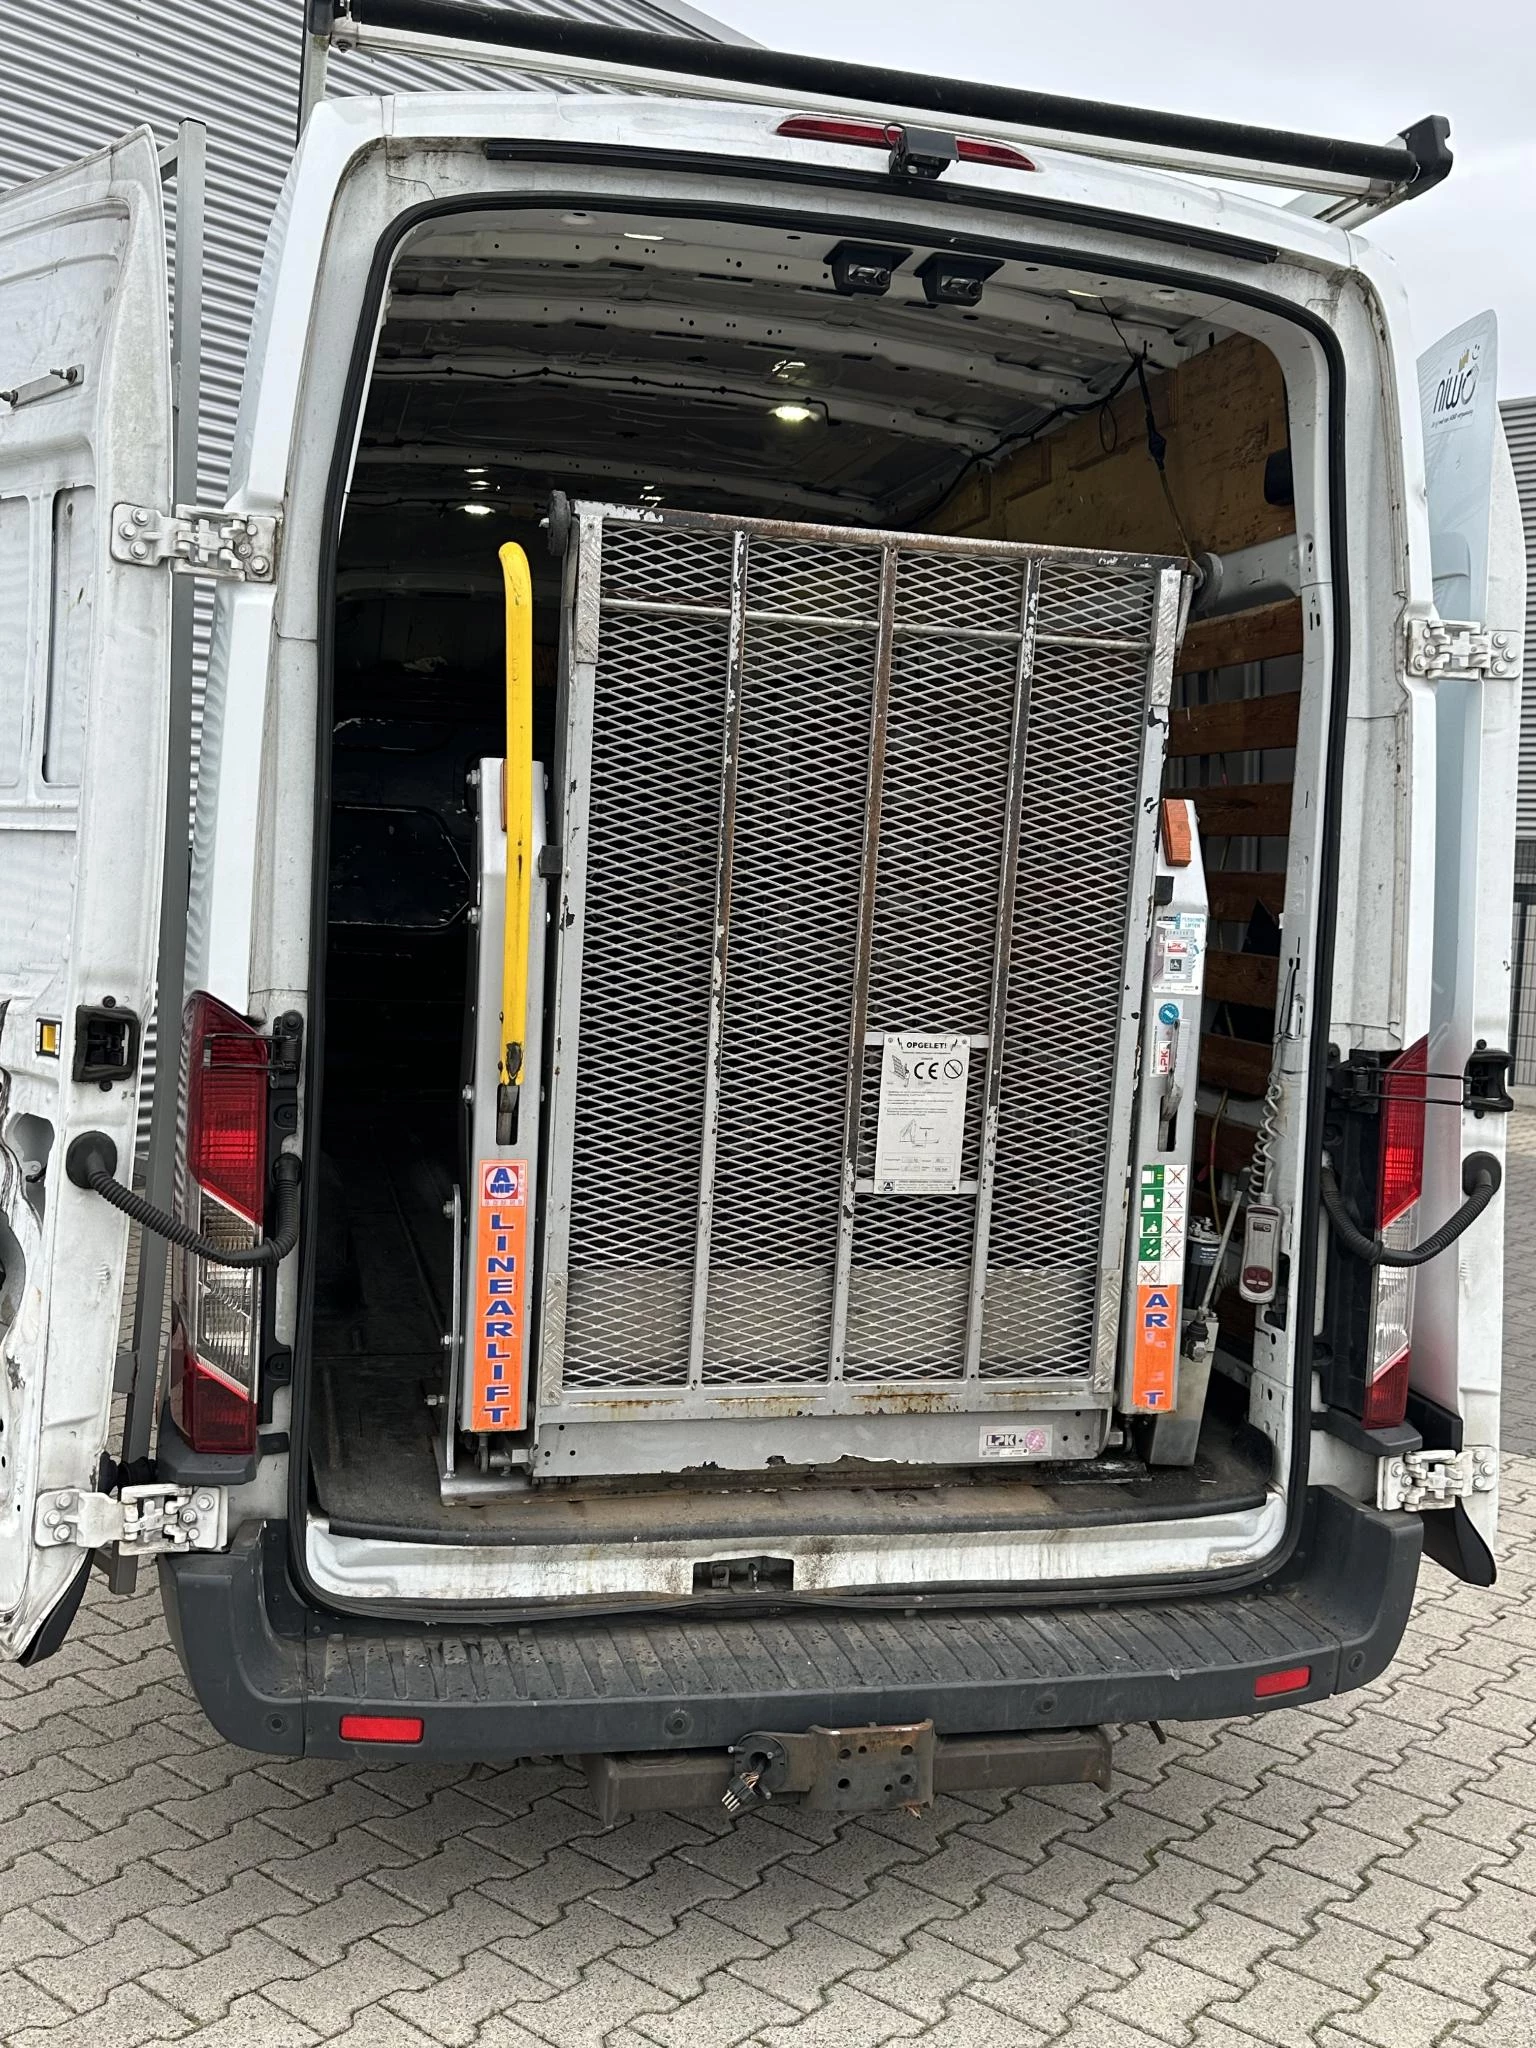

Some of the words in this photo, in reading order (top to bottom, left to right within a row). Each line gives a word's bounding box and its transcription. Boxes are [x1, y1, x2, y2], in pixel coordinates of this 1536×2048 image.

[914, 1062, 939, 1080] CE
[1160, 1050, 1169, 1073] LPK
[484, 1214, 515, 1423] LINEARLIFT
[986, 1434, 1016, 1446] LPK
